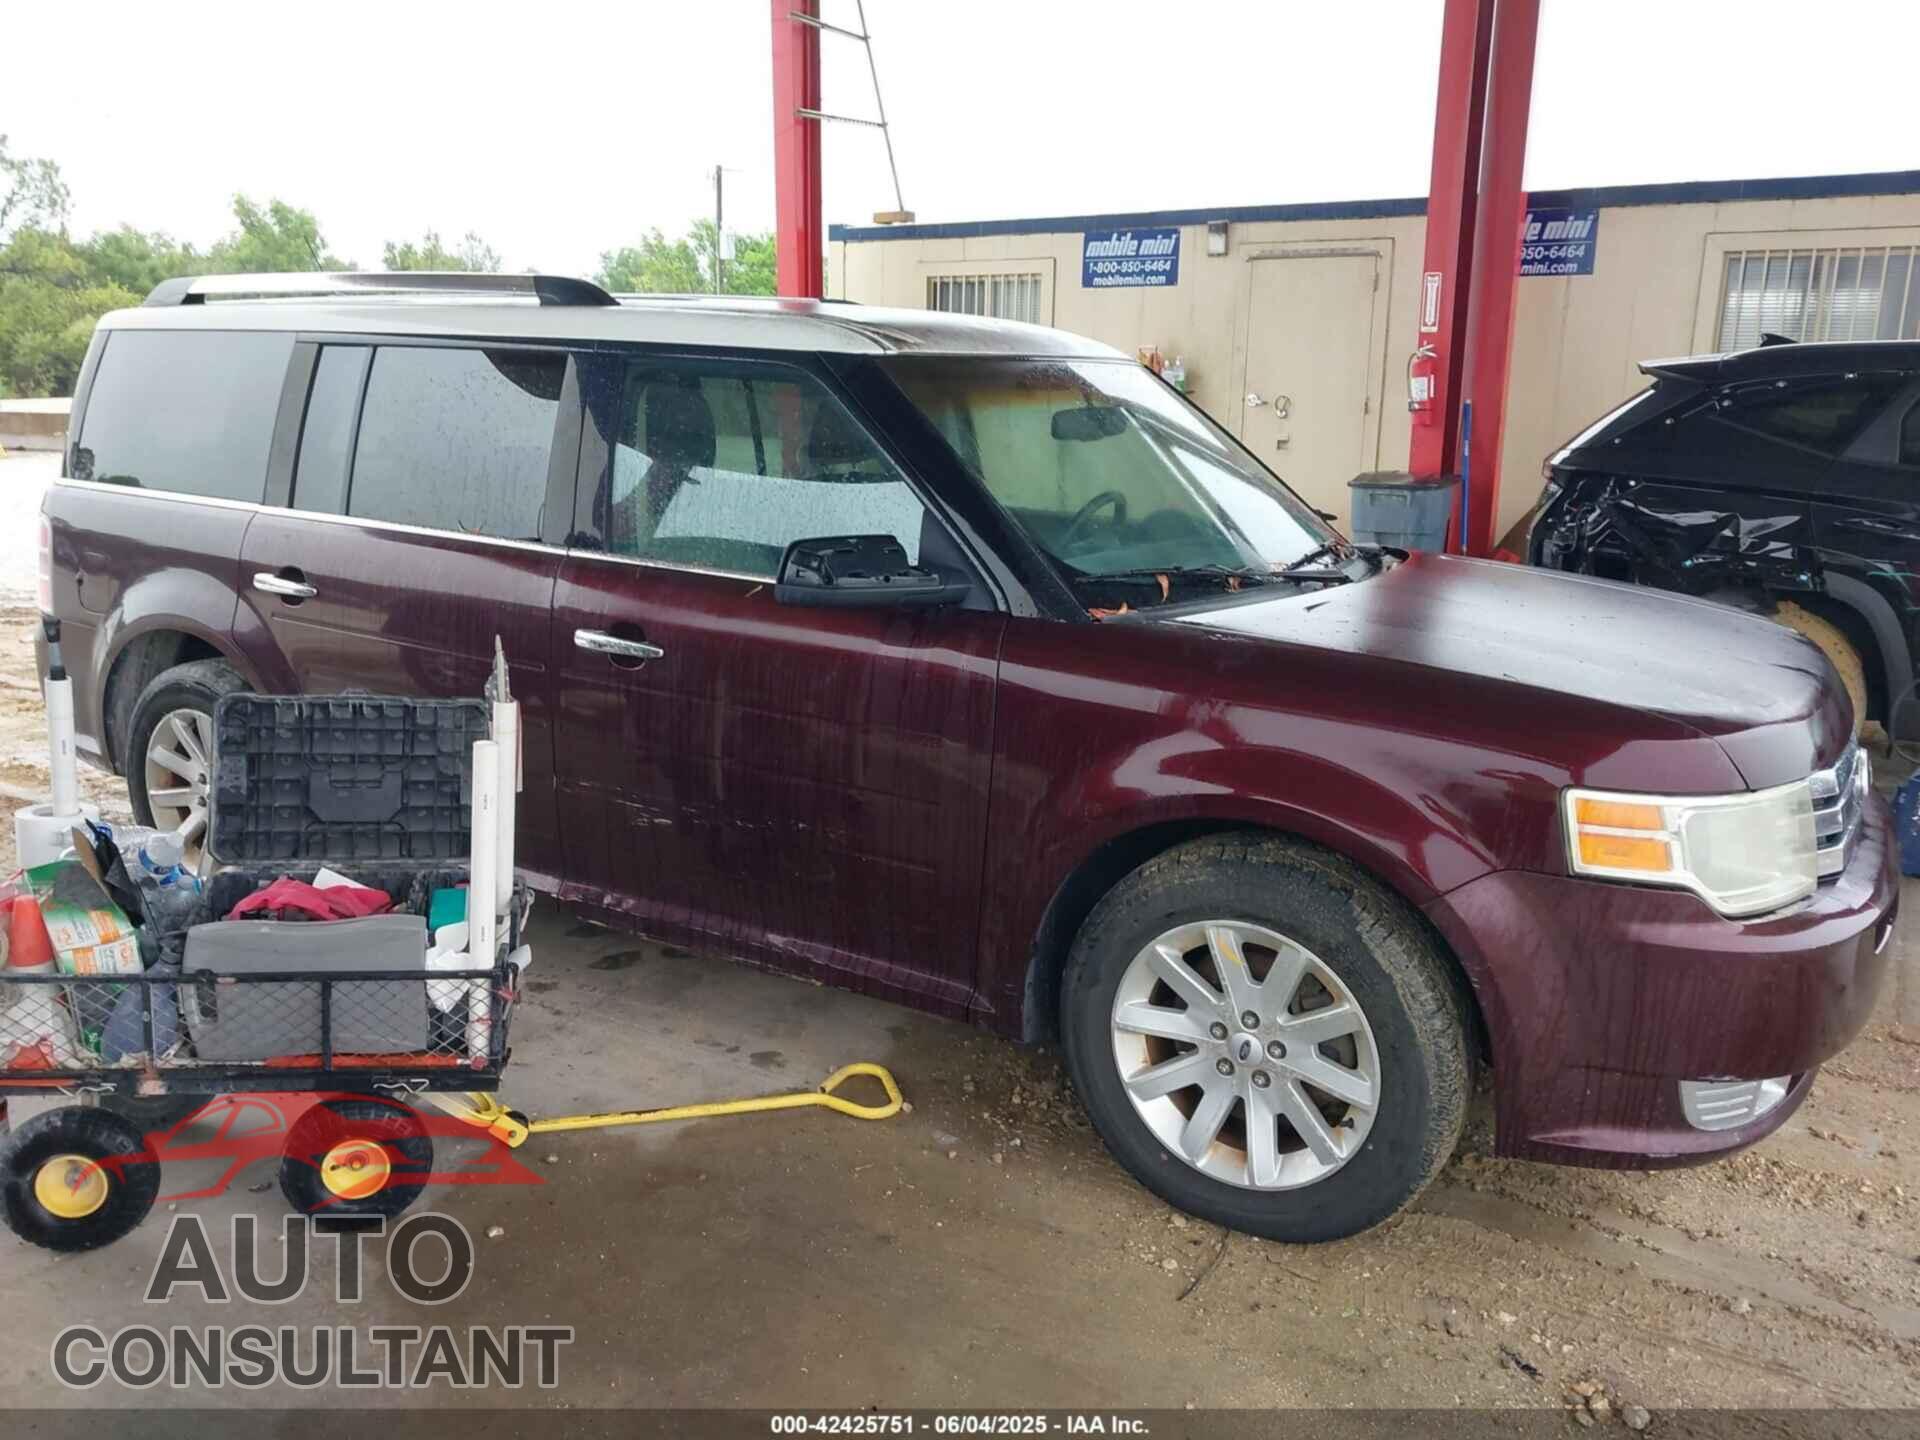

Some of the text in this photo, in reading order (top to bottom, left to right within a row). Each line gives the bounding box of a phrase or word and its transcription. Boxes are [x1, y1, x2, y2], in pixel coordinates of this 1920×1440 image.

[1542, 214, 1594, 240] mini
[1085, 232, 1177, 257] mobile mini
[1088, 259, 1172, 274] 1-800-950-6464
[1092, 274, 1167, 286] mobilemini.com
